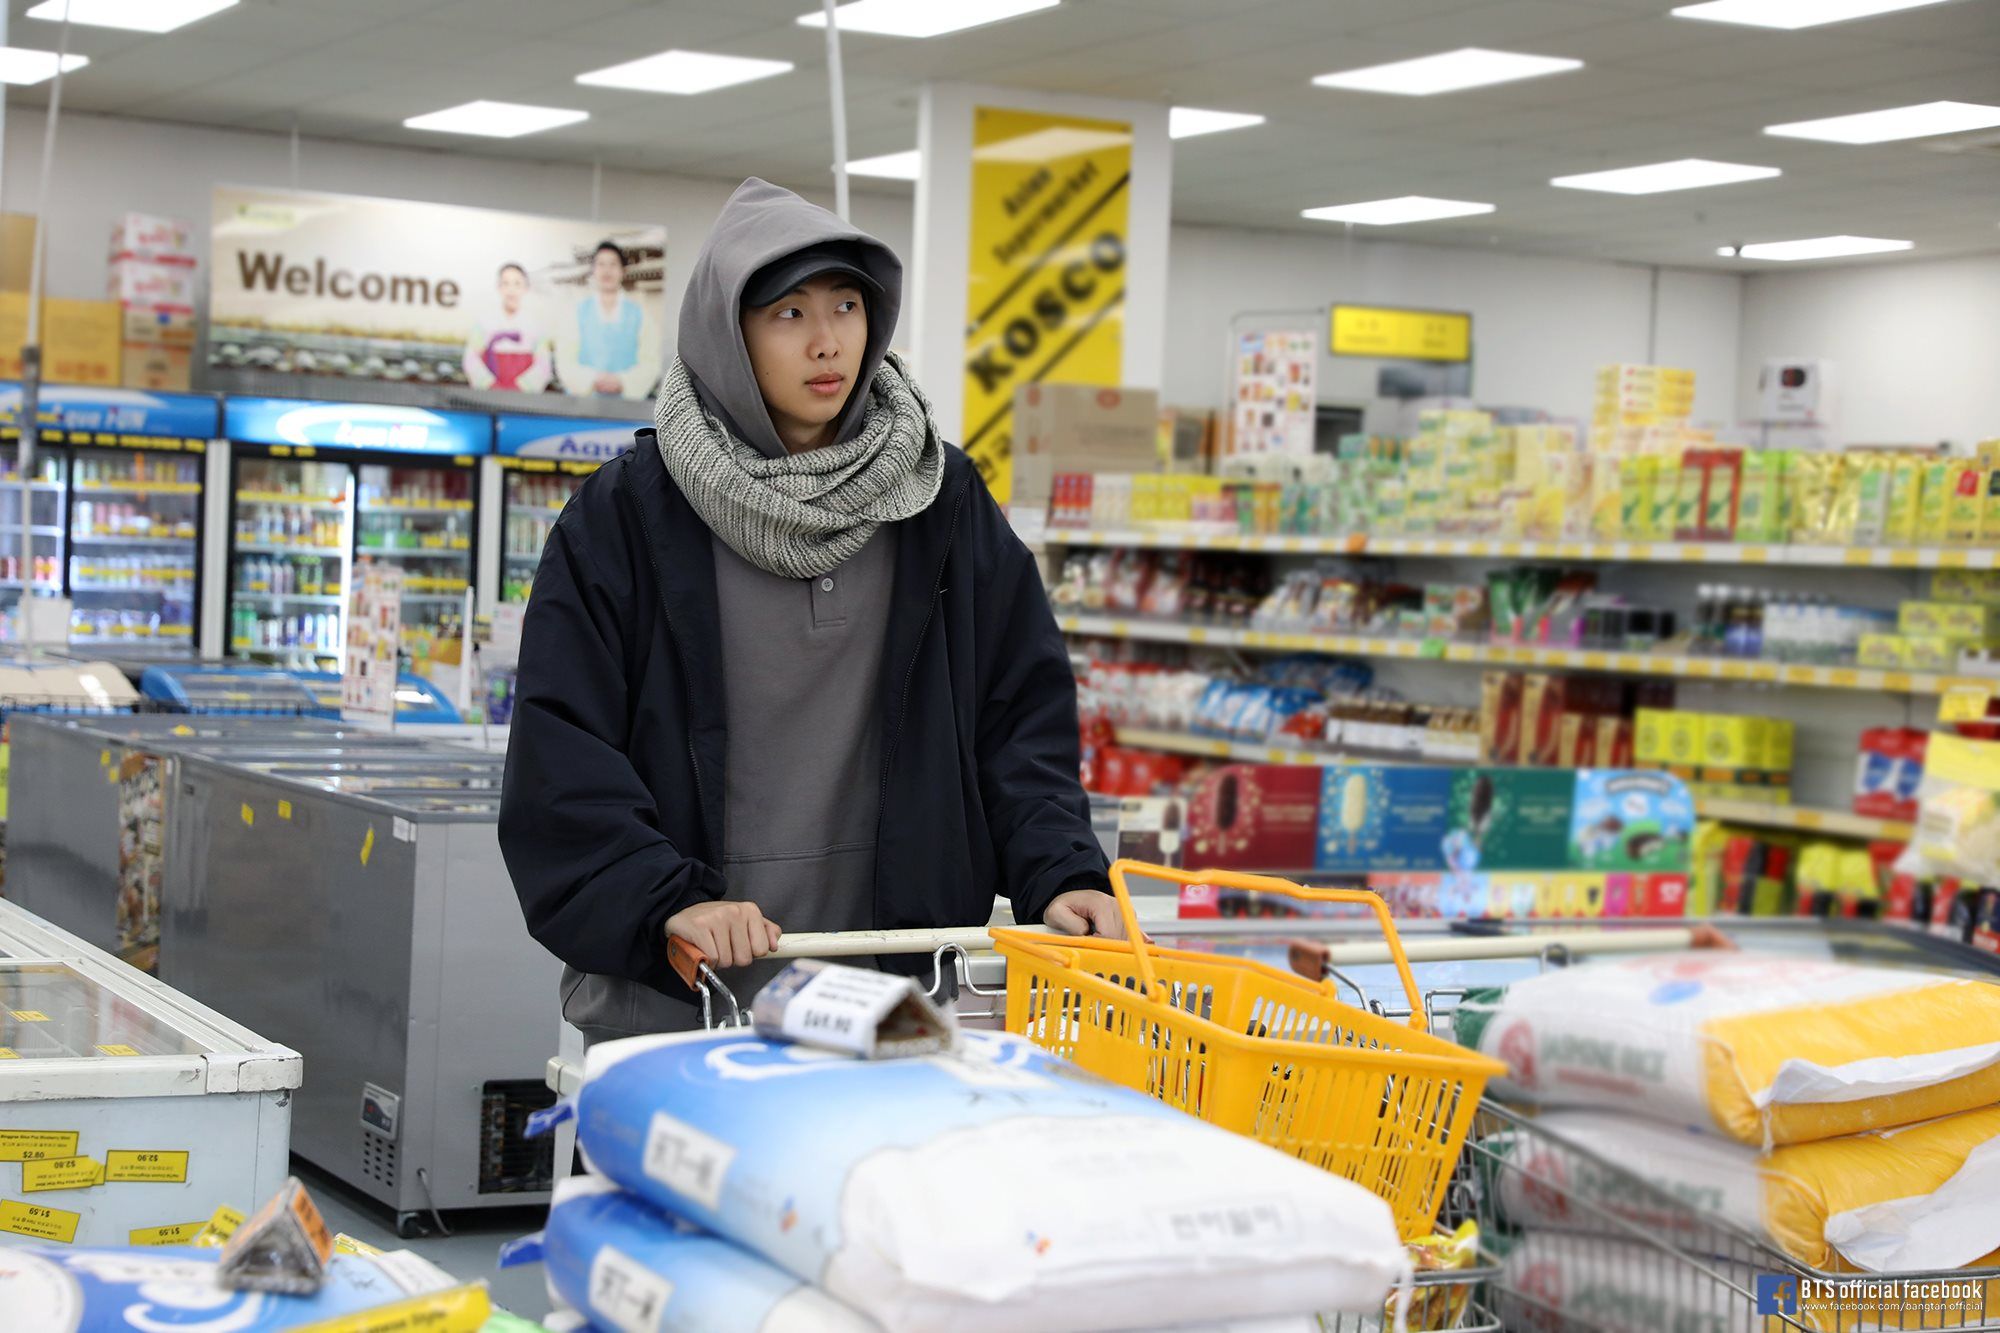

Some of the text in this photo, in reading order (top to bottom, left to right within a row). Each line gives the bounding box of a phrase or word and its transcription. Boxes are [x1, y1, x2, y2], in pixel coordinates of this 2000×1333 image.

[237, 250, 460, 308] Welcome
[967, 231, 1125, 394] KOSCO
[137, 1154, 159, 1162] $2.90
[29, 1207, 51, 1218] $1.59
[159, 1227, 180, 1236] $1.59
